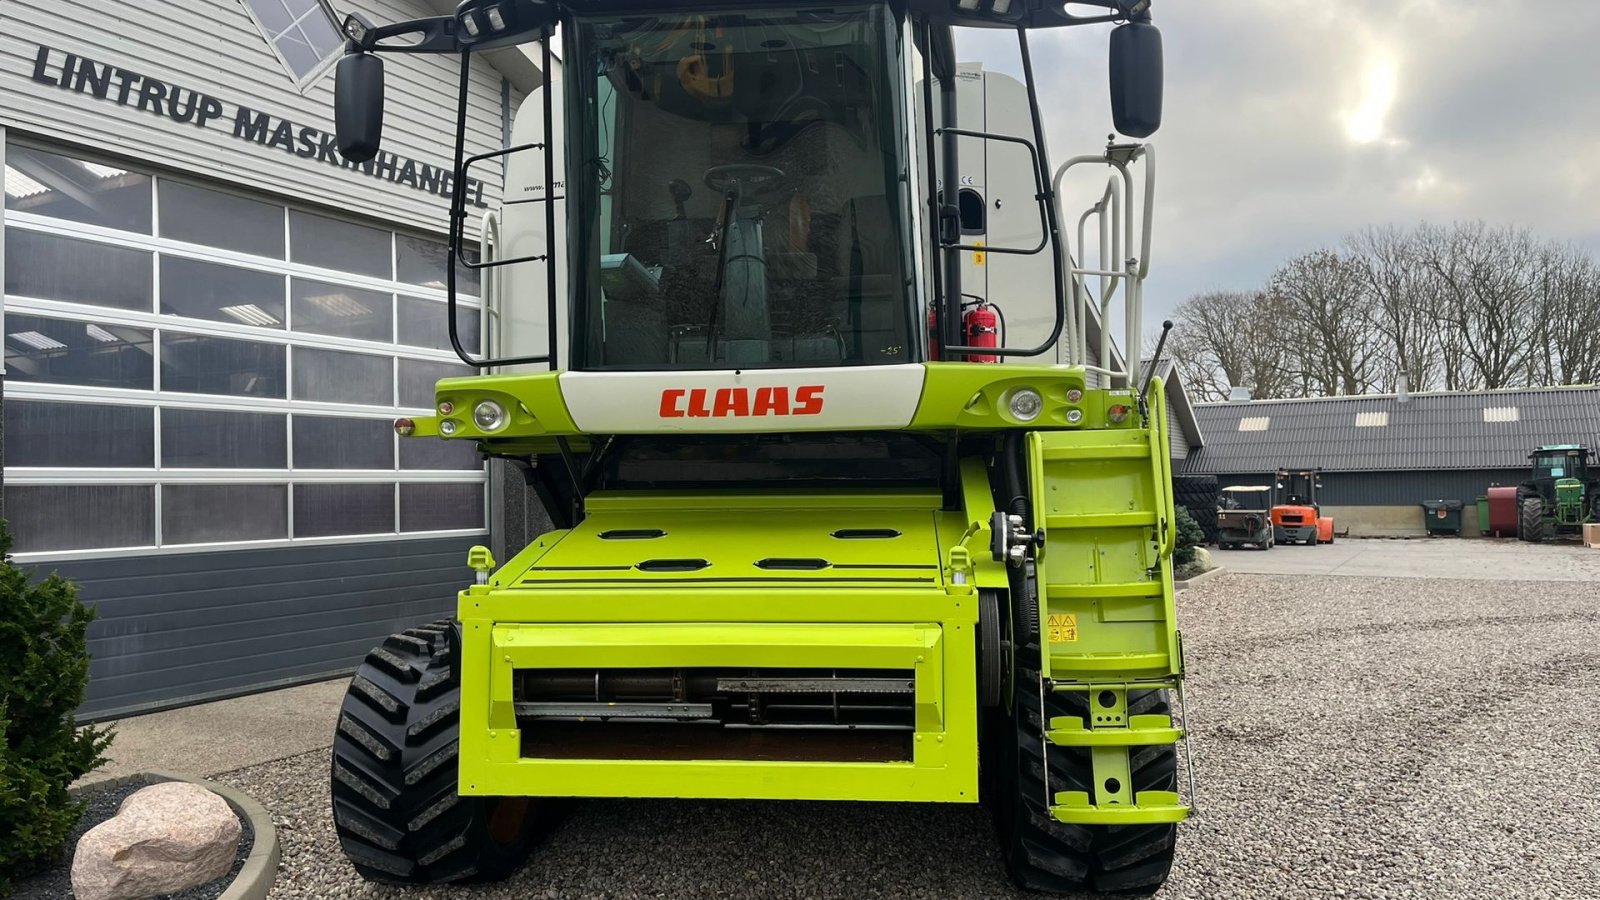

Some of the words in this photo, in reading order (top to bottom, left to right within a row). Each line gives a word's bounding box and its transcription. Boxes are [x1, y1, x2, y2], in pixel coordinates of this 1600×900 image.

[33, 45, 222, 128] LINTRUP
[232, 104, 488, 209] MASKHANDEL
[659, 385, 825, 418] CLAAS
